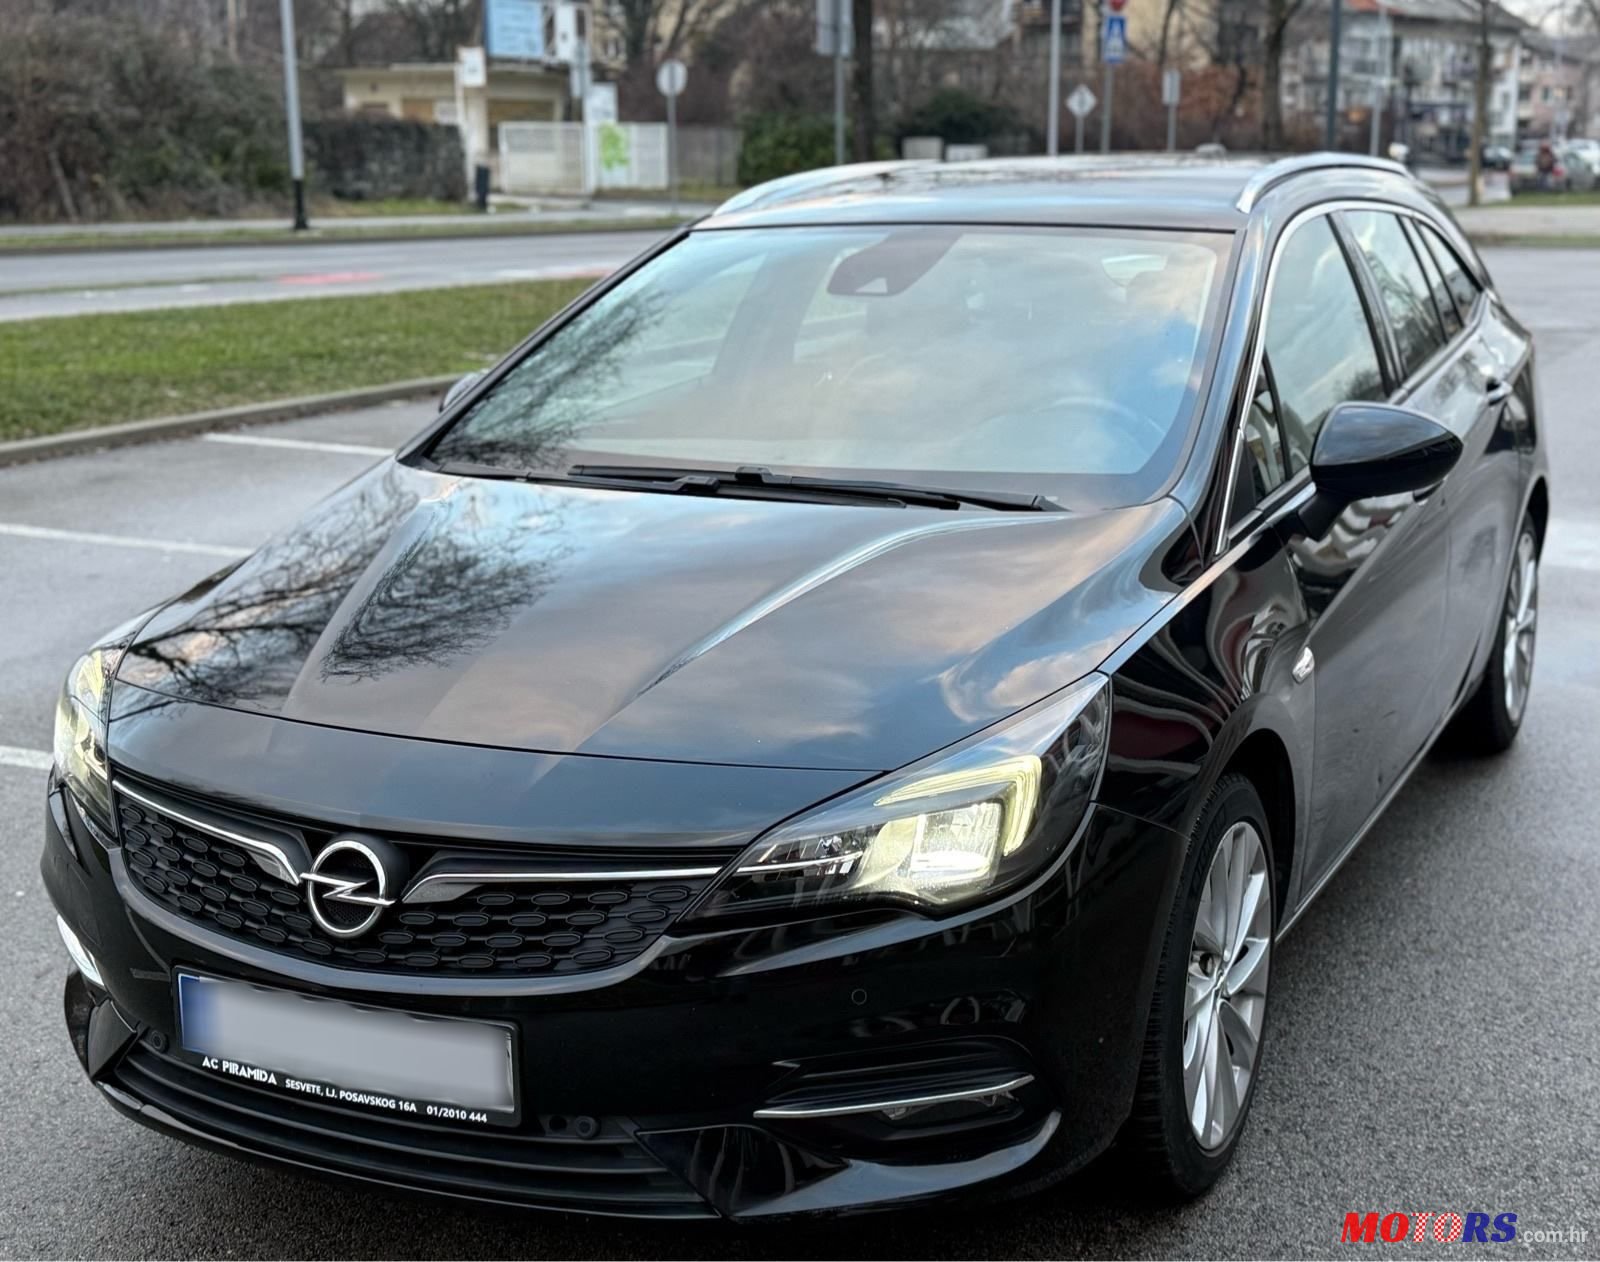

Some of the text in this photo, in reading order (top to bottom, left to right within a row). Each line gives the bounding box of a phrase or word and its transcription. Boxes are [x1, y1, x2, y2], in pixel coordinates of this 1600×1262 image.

[202, 1056, 488, 1124] AC PIRAMIDA SESVETE, LJ. POSAVSKOG 16A 01/2010 444
